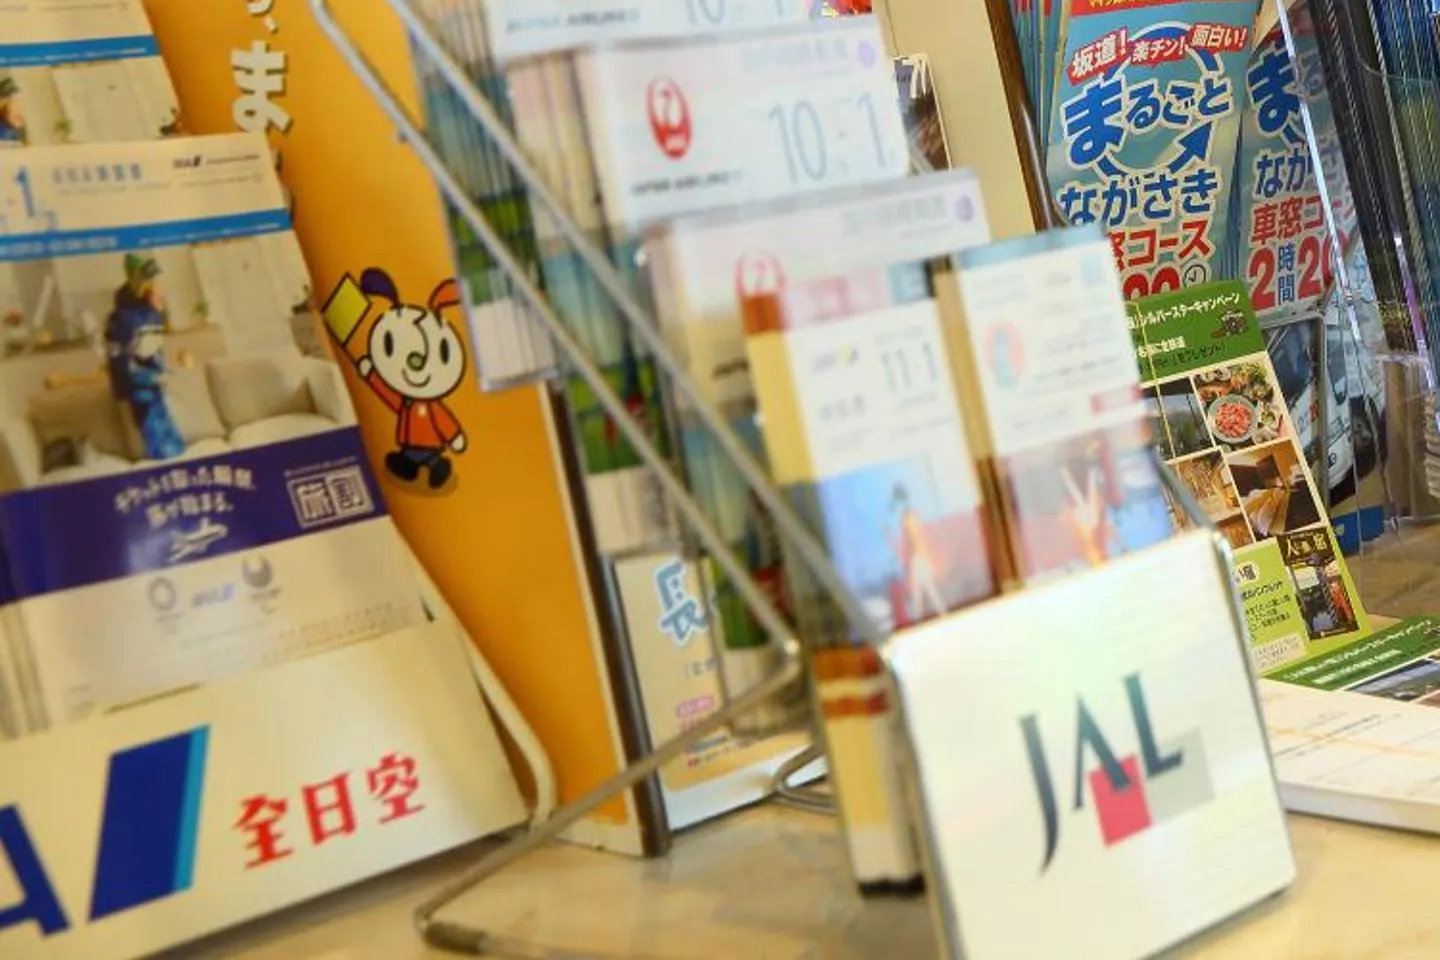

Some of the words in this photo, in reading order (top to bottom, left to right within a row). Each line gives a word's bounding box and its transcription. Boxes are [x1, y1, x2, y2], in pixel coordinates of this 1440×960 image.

[1061, 70, 1232, 166] まるごと
[1061, 168, 1219, 227] ながさき
[234, 751, 426, 869] 全日空
[1018, 670, 1185, 876] JAL
